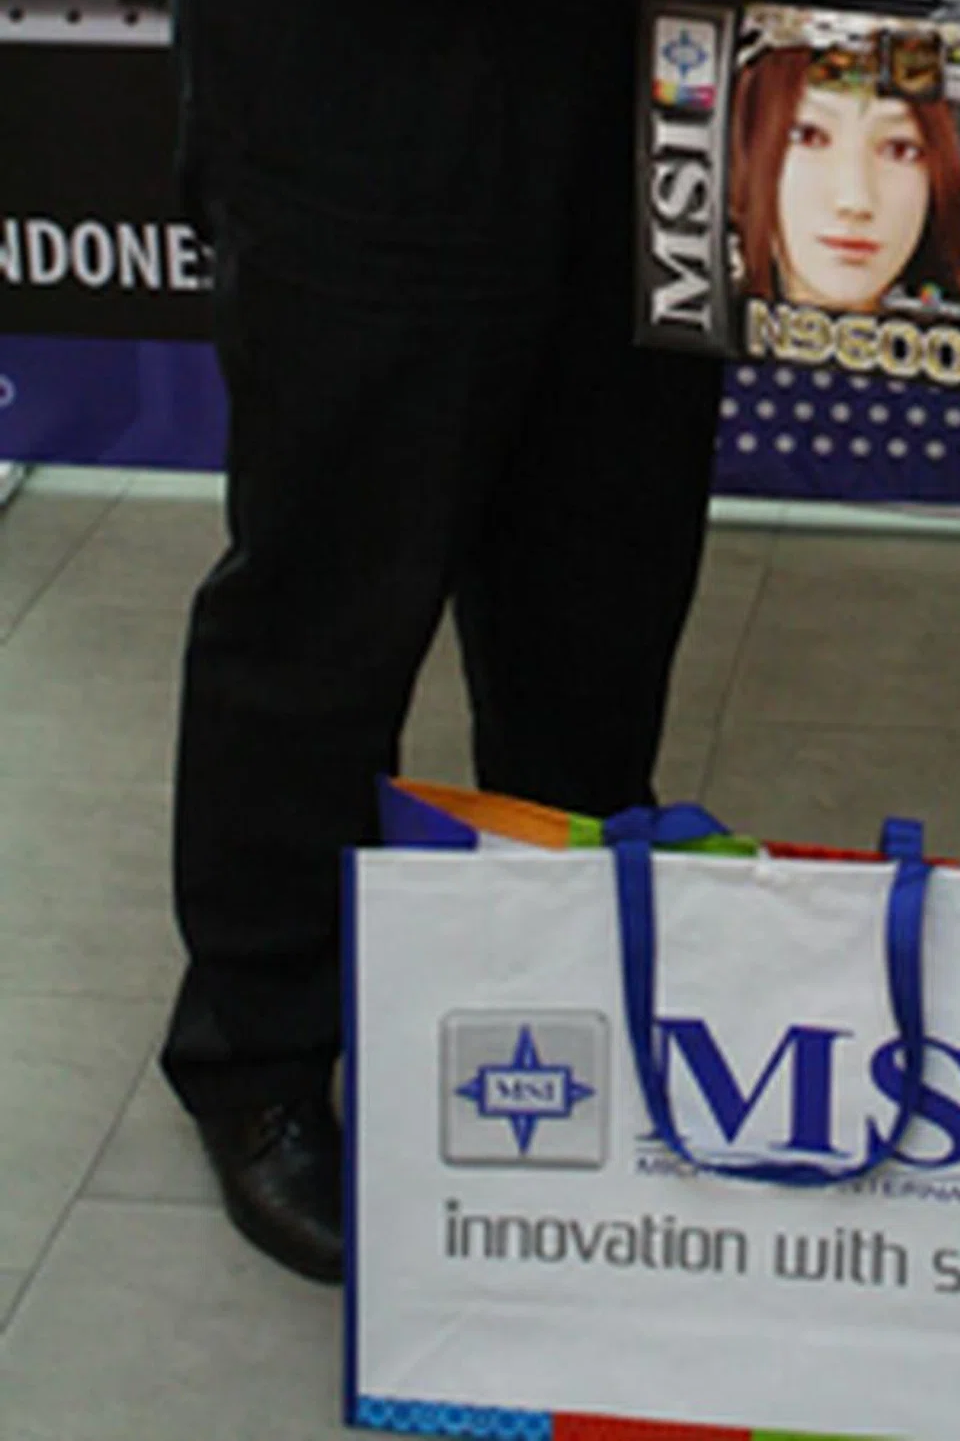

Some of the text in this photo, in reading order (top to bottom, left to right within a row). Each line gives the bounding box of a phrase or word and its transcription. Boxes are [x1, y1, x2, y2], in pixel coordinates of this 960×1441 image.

[651, 111, 713, 333] MSI
[444, 1200, 748, 1276] innovation
[774, 1227, 909, 1288] with
